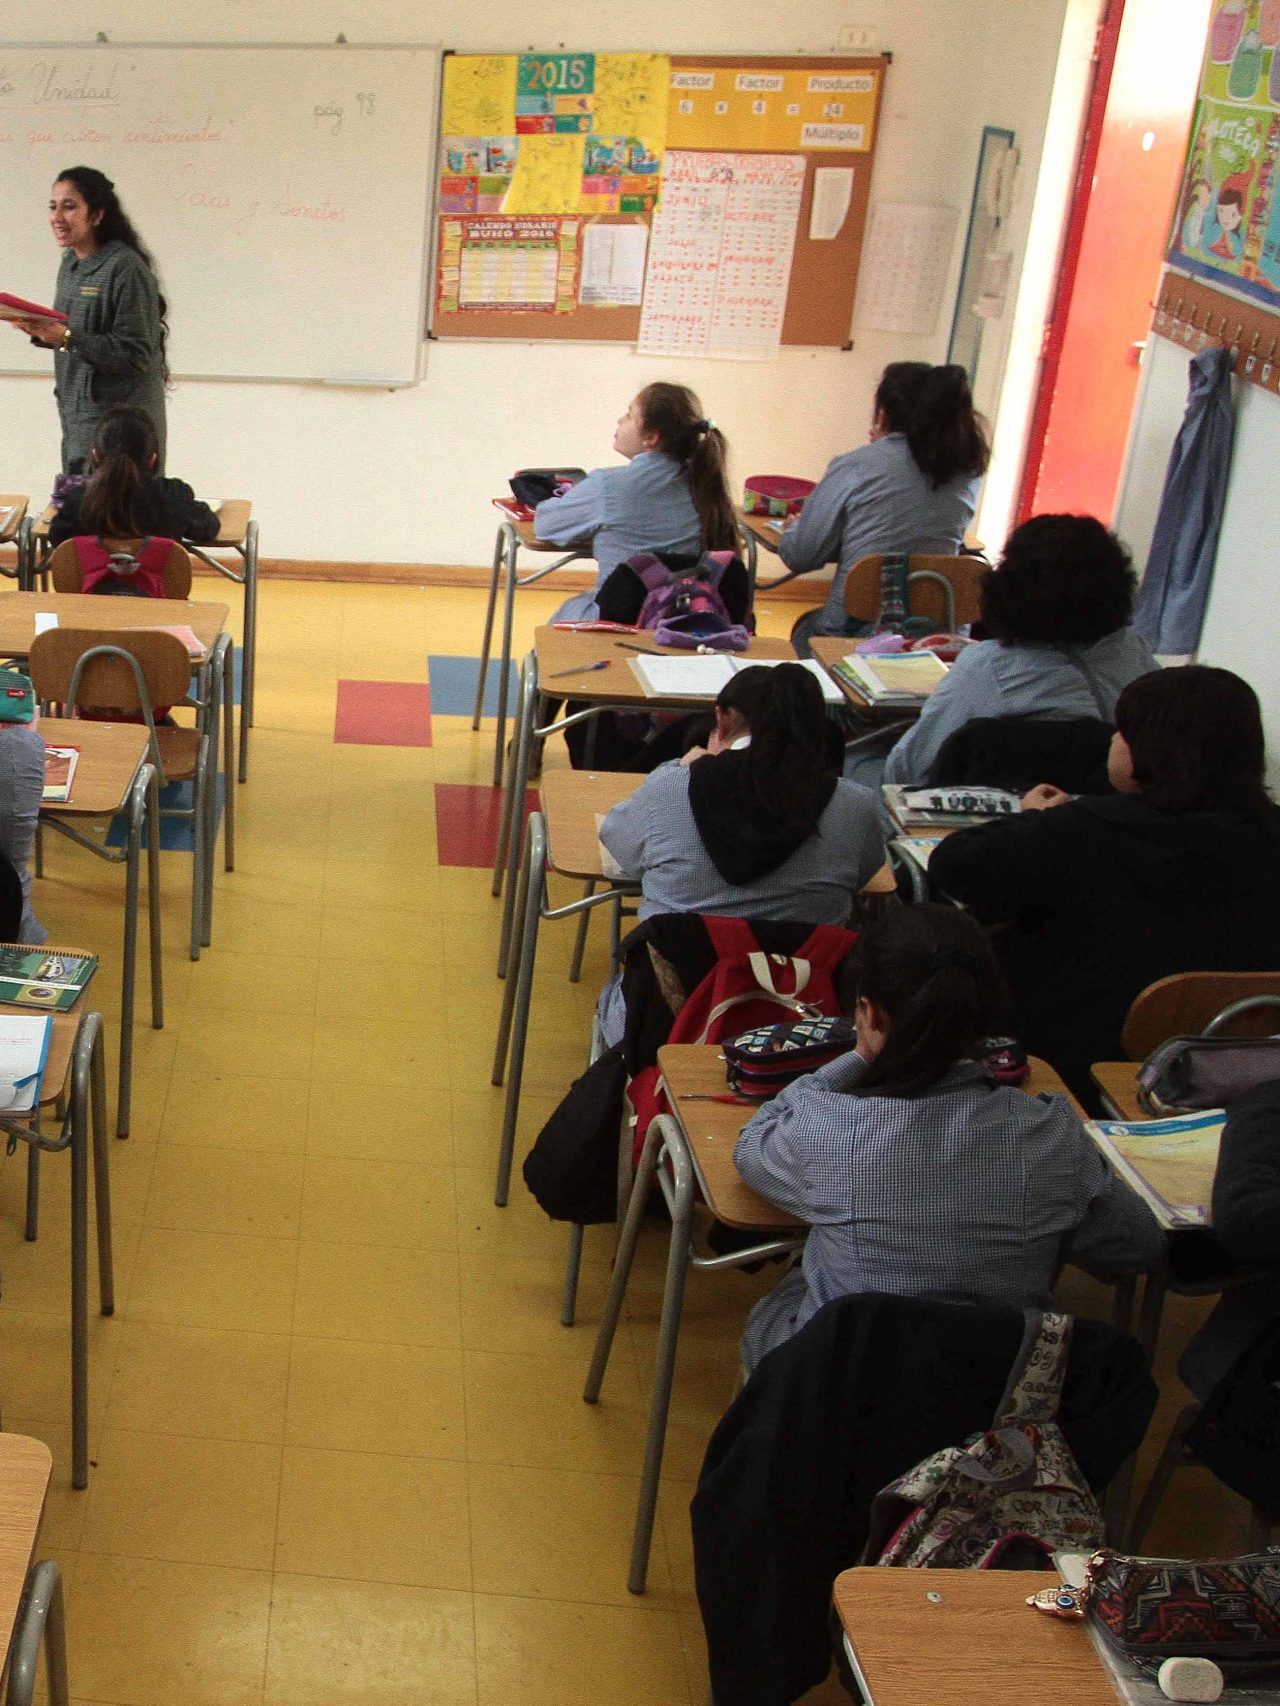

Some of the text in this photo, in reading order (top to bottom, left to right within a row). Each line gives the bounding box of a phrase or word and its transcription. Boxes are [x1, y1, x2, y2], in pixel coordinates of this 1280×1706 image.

[26, 62, 120, 104] Unidad
[527, 59, 587, 89] 2015
[739, 76, 780, 88] Factor
[810, 77, 870, 90] Producto
